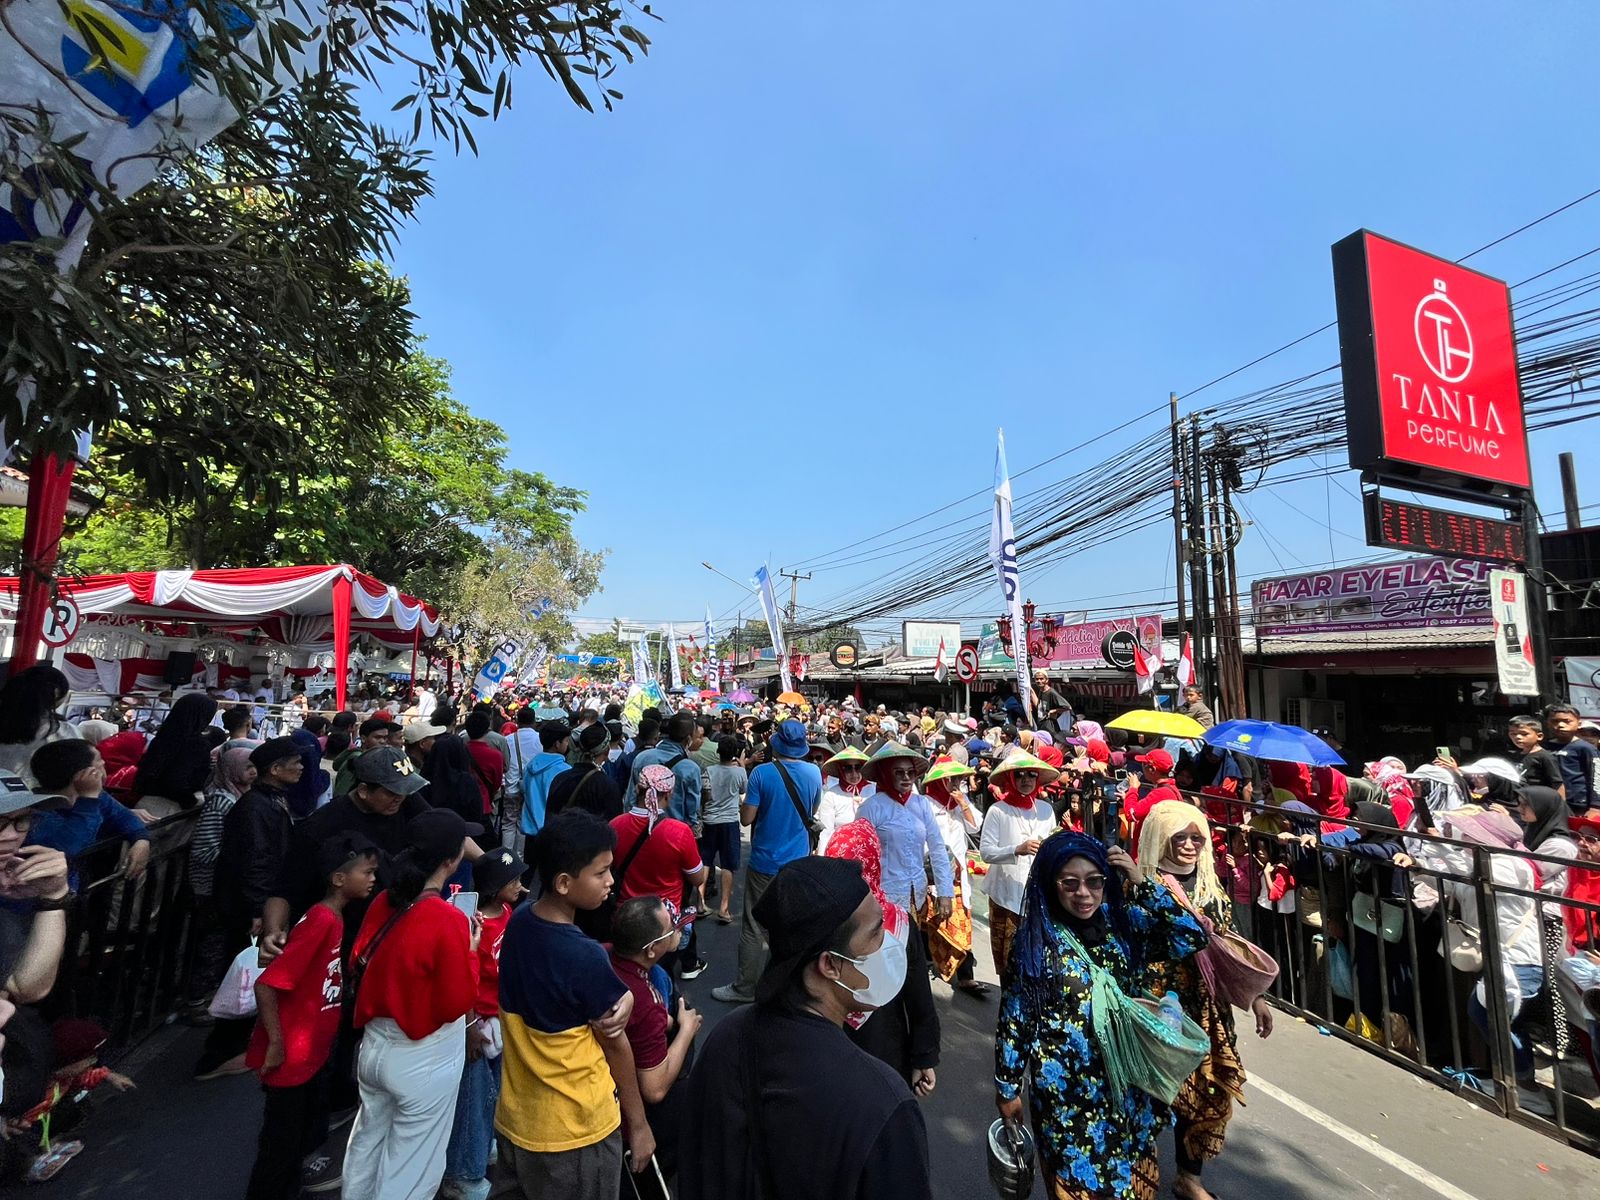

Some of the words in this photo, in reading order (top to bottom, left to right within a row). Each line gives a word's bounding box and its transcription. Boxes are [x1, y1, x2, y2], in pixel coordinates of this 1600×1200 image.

[1392, 373, 1505, 435] TANIA
[1257, 574, 1334, 604] HAAR
[47, 606, 71, 636] P
[961, 651, 976, 676] S
[393, 756, 414, 776] W
